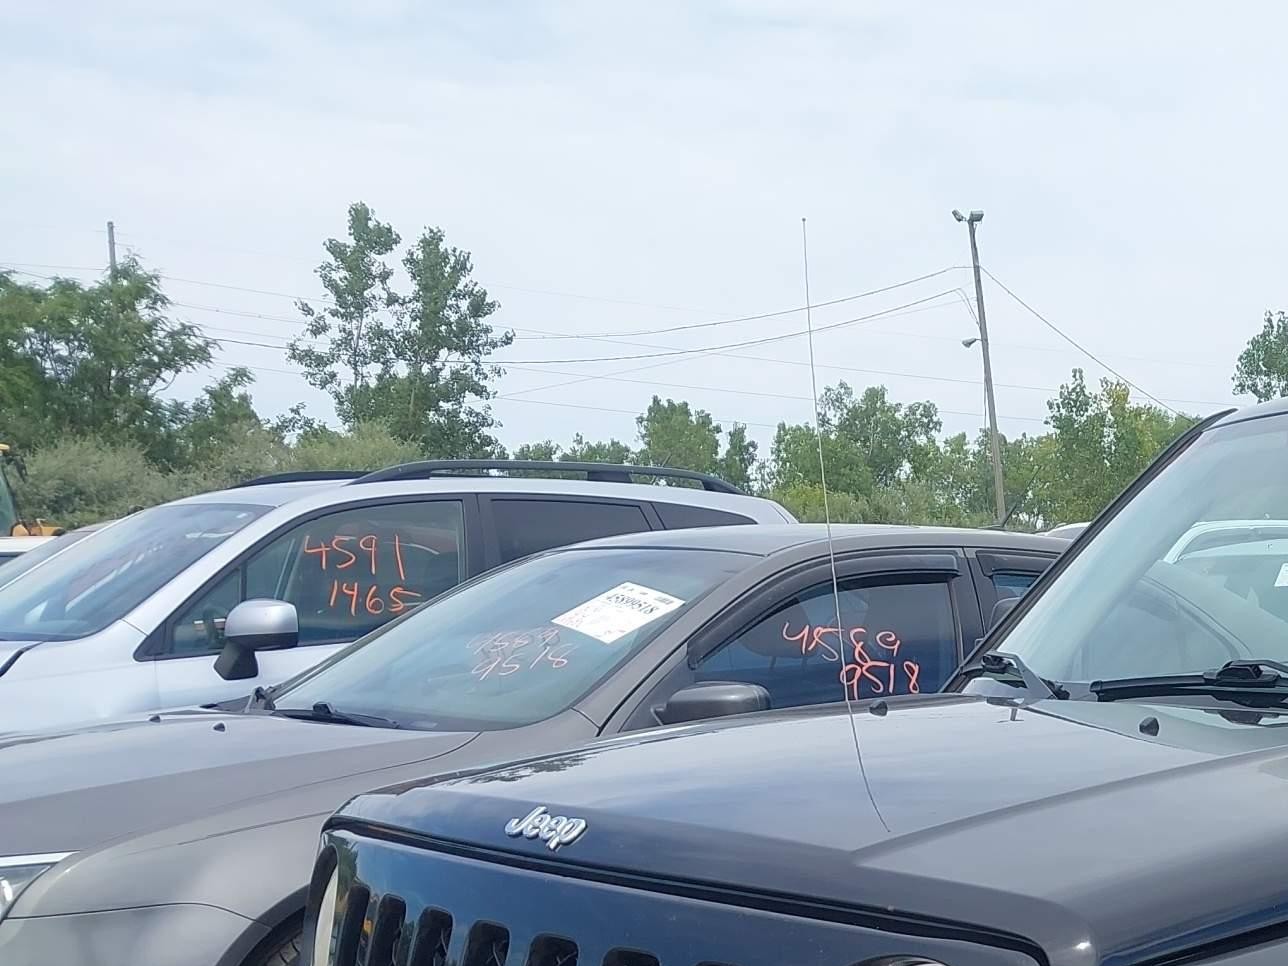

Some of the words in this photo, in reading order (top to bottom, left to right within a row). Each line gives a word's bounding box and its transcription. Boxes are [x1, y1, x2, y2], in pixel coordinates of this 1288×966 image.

[303, 533, 405, 581] 4591
[329, 579, 422, 617] 1465
[471, 643, 578, 681] 9518
[782, 621, 901, 666] 4589
[839, 660, 920, 701] 9518
[504, 805, 588, 852] Jeep
